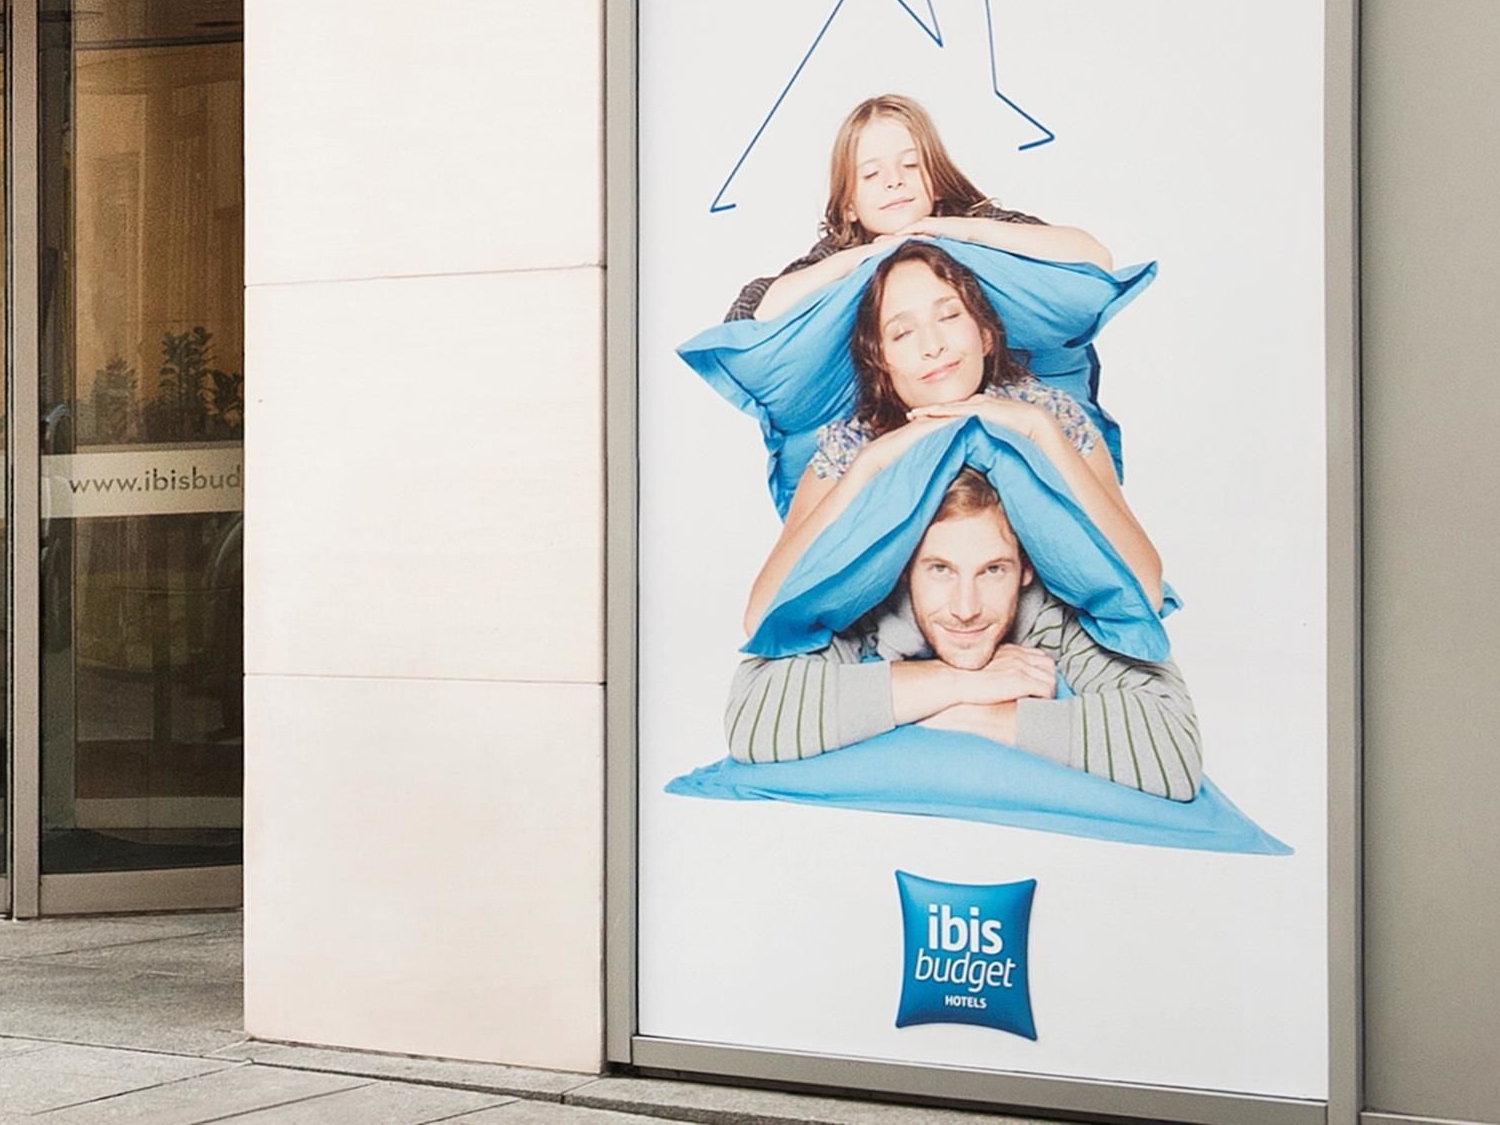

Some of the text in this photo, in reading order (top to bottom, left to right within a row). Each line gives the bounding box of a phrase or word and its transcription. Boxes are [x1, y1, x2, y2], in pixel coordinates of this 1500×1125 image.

[68, 464, 242, 494] www.ibisbud
[928, 903, 1003, 955] ibis
[915, 947, 1016, 993] budget
[944, 994, 987, 1009] HOTELS
